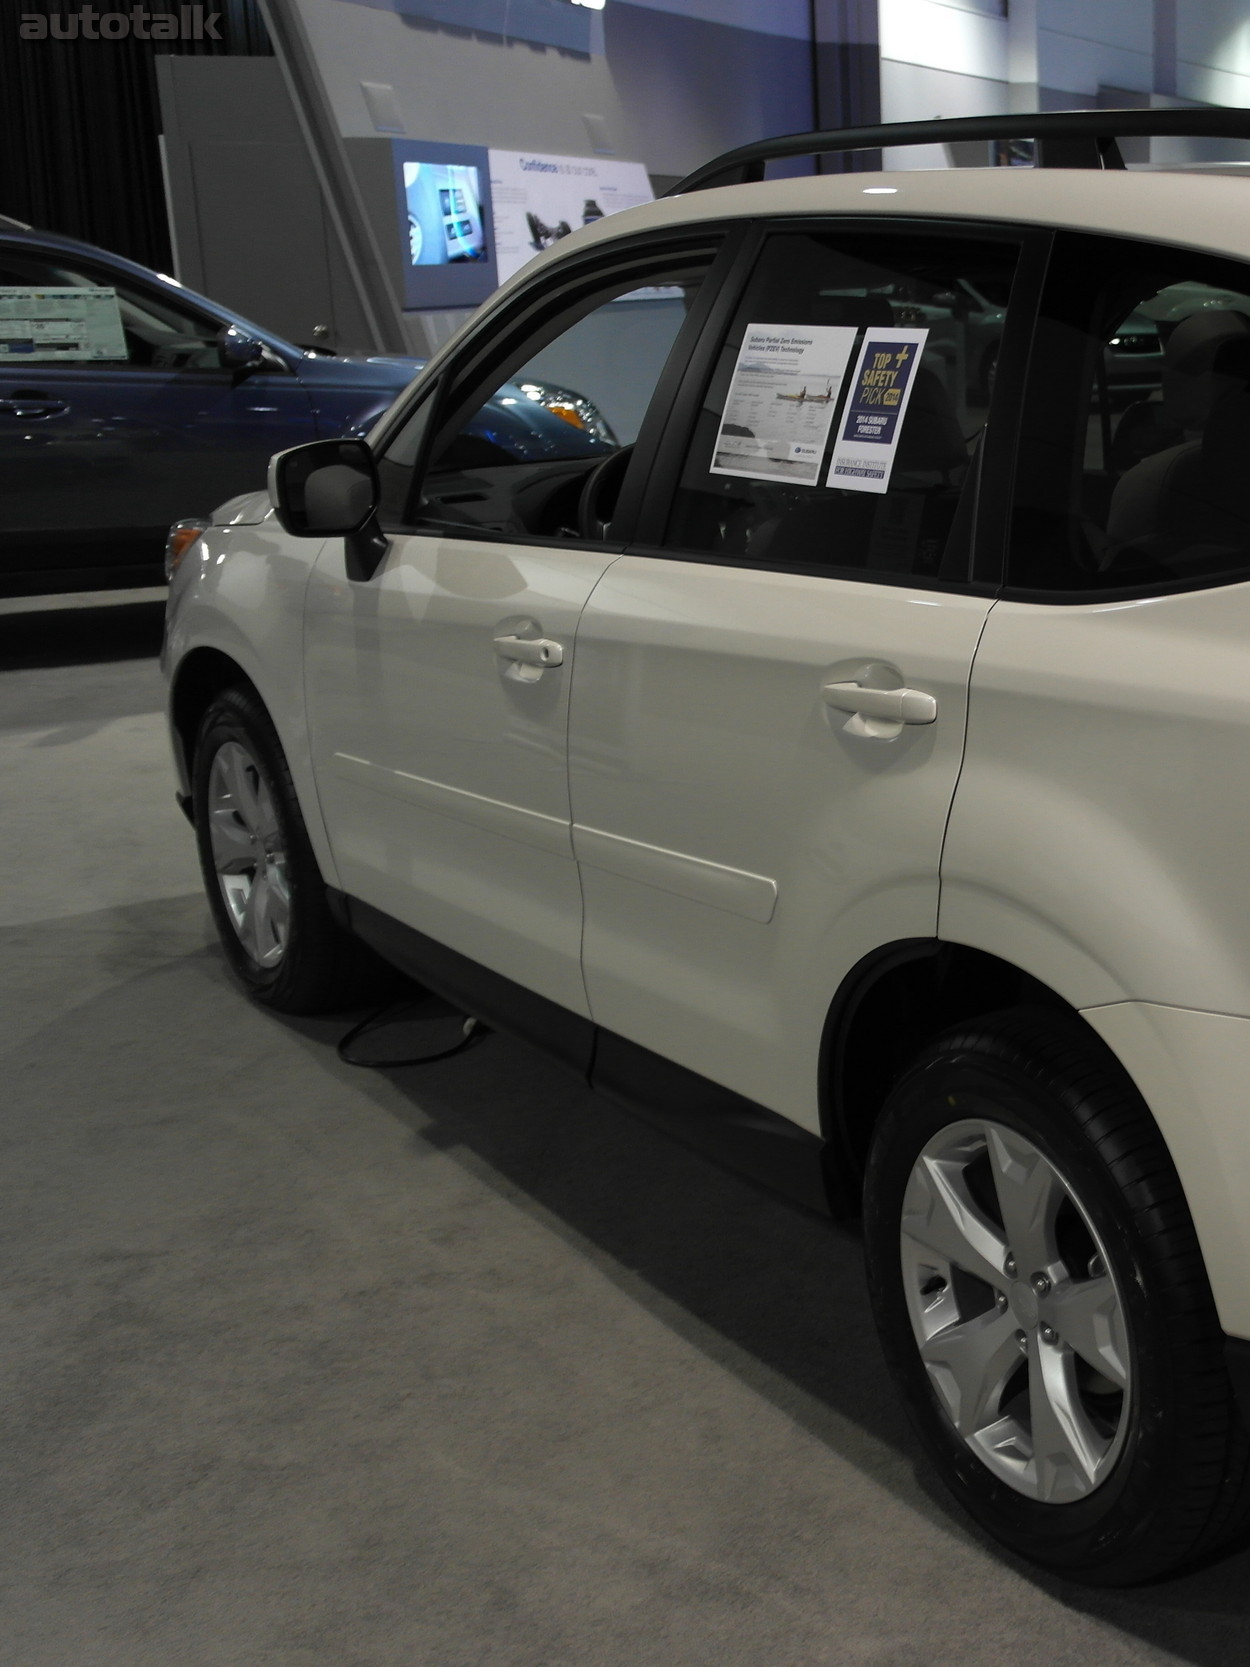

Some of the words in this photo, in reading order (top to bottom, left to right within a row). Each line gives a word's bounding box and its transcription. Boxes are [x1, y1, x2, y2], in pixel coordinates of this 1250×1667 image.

[872, 353, 892, 369] TOP
[861, 369, 899, 387] SAFETY
[859, 388, 887, 405] PICK
[856, 415, 868, 424] 2014
[868, 416, 888, 426] SUBARU
[857, 425, 882, 435] FORESTER
